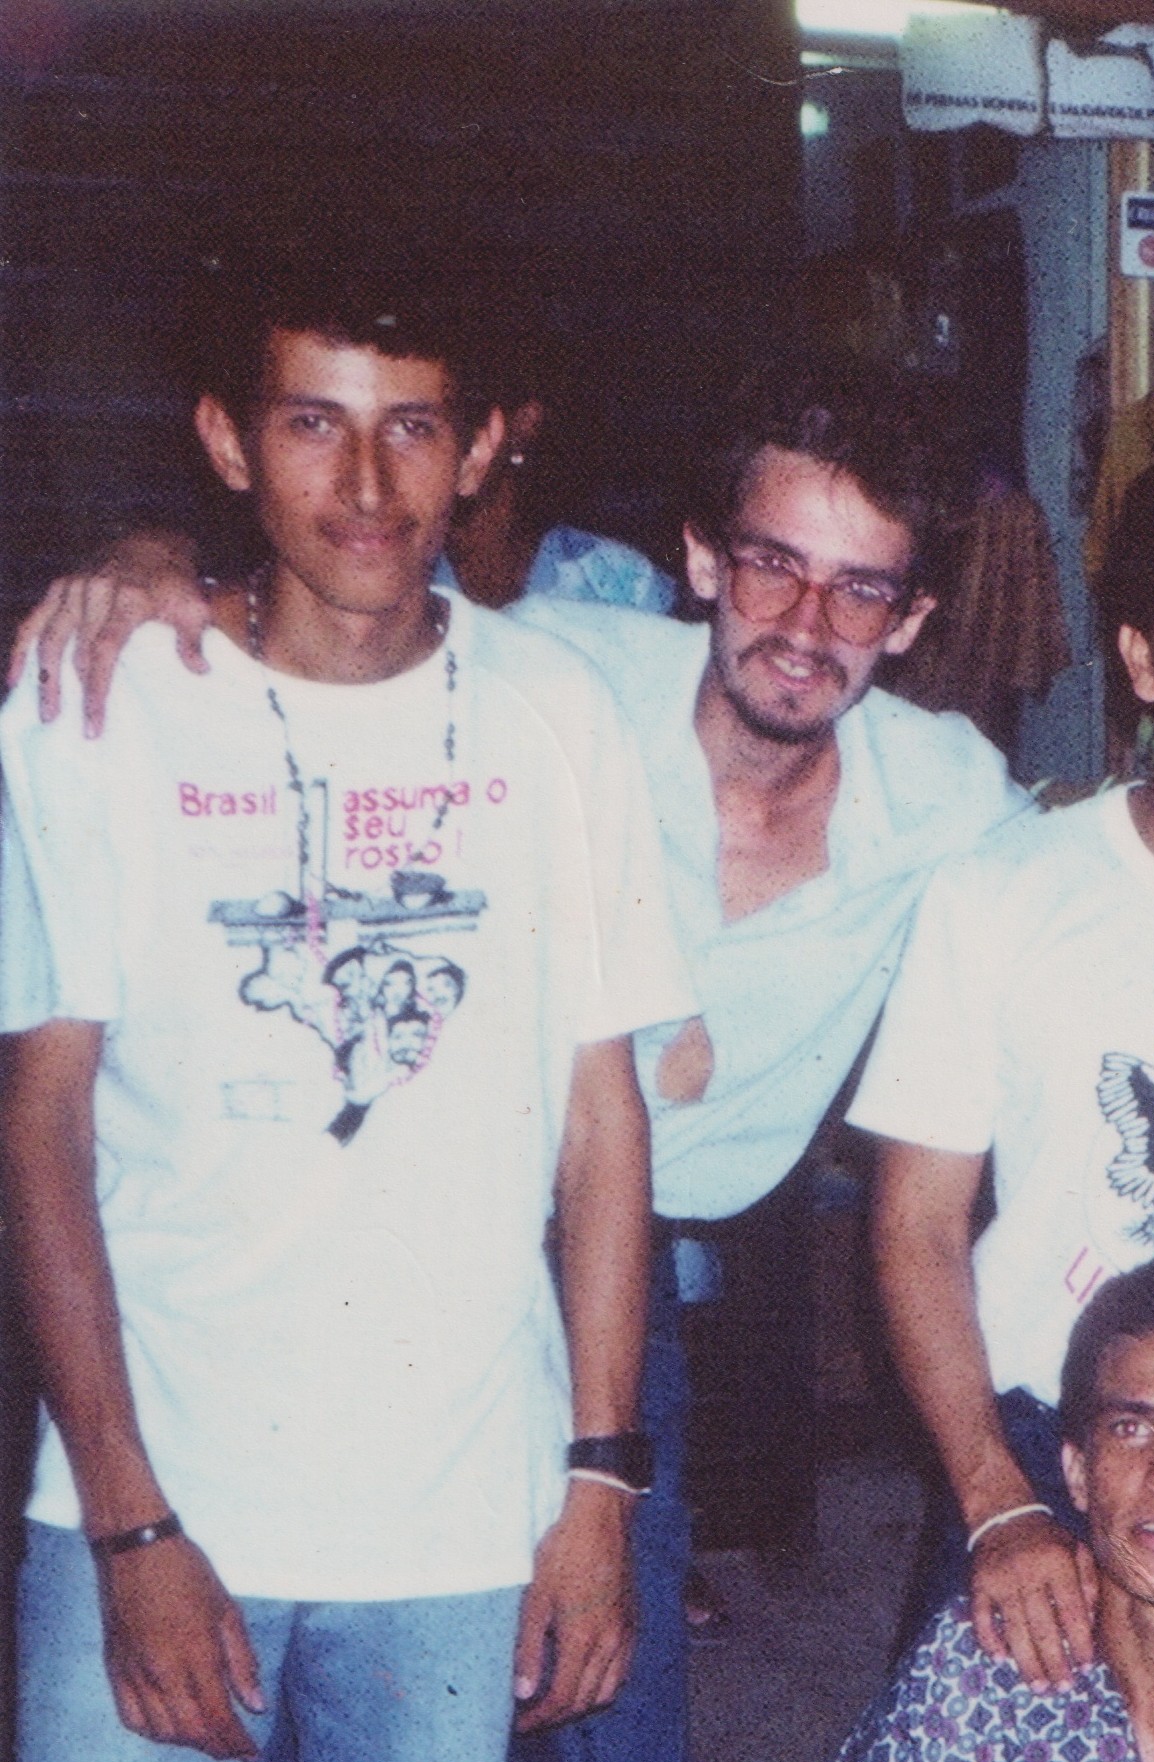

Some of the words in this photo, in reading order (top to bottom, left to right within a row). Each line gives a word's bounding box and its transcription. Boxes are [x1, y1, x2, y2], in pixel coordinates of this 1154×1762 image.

[178, 781, 277, 817] Brasil
[343, 780, 470, 813] assuma
[344, 813, 407, 841] seu
